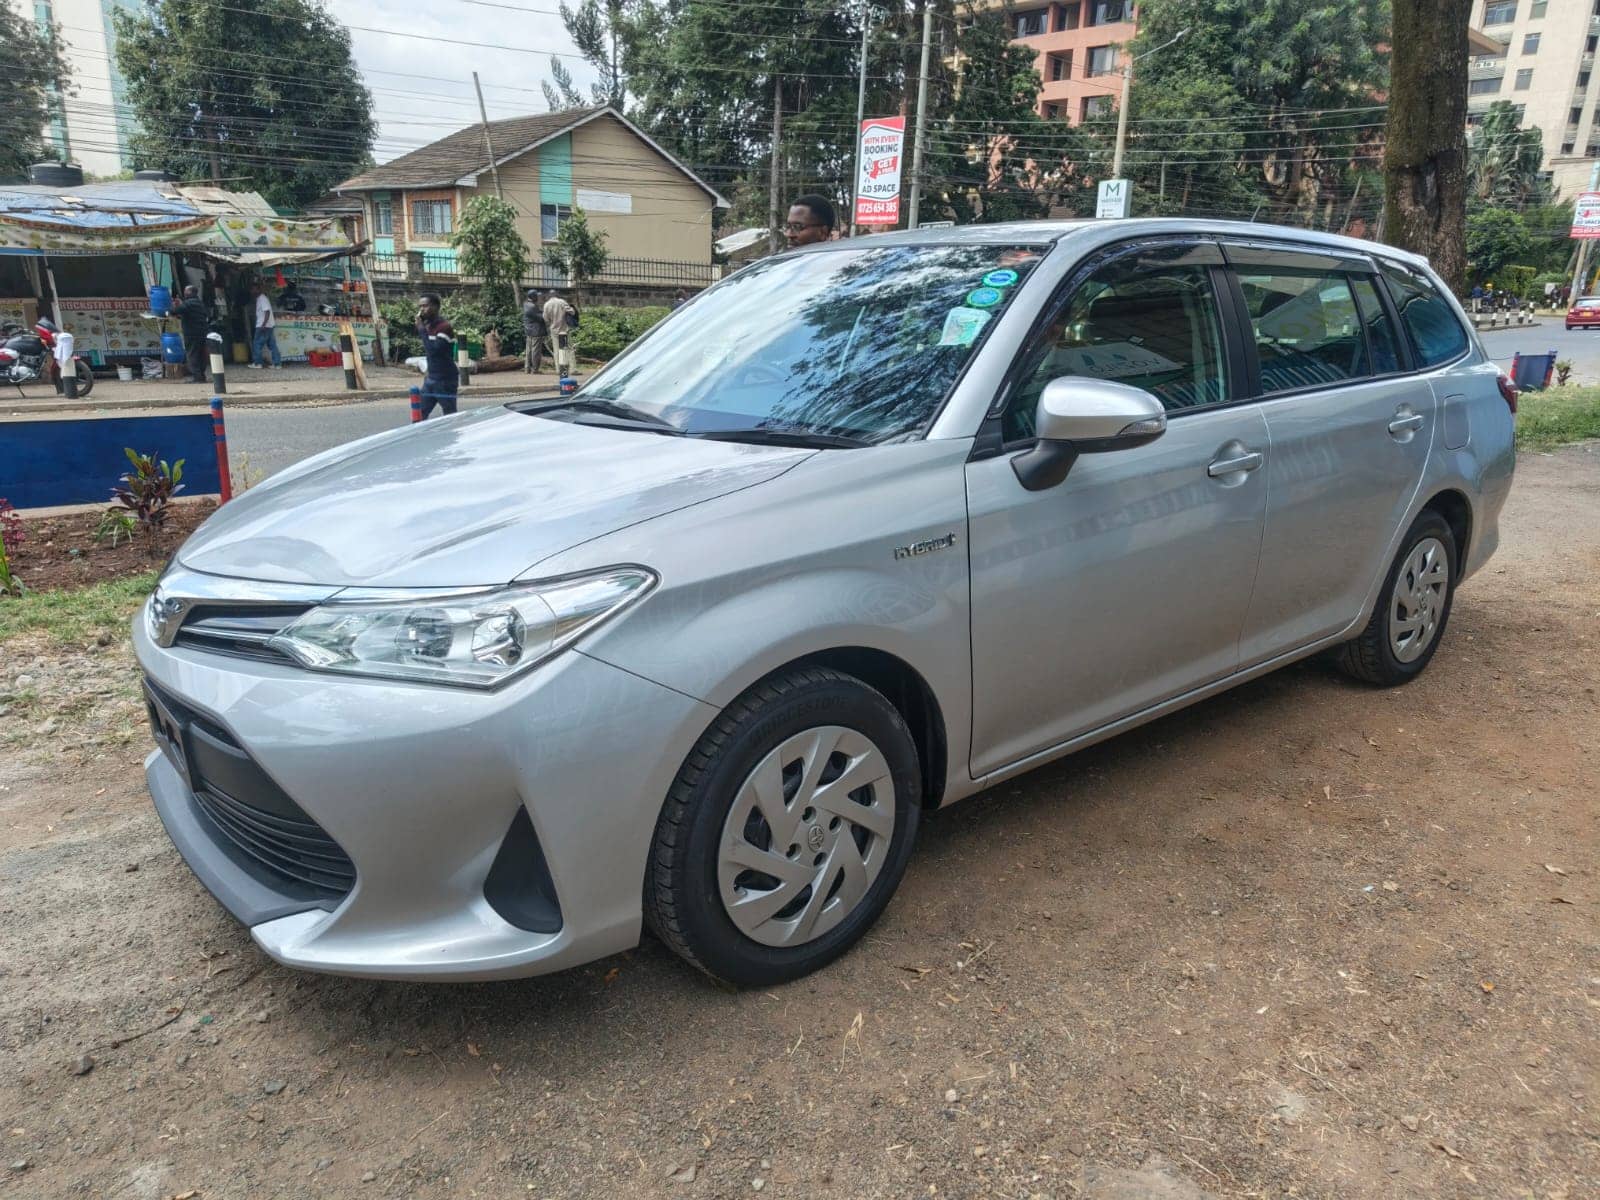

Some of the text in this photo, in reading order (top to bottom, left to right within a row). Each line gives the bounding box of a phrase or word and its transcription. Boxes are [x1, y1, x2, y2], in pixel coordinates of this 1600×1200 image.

[864, 144, 898, 154] BOOKING
[878, 159, 893, 169] GET
[862, 183, 896, 193] AD SPACE
[1105, 183, 1120, 197] M
[60, 301, 112, 311] ROCKSTAR
[294, 321, 313, 329] BEST
